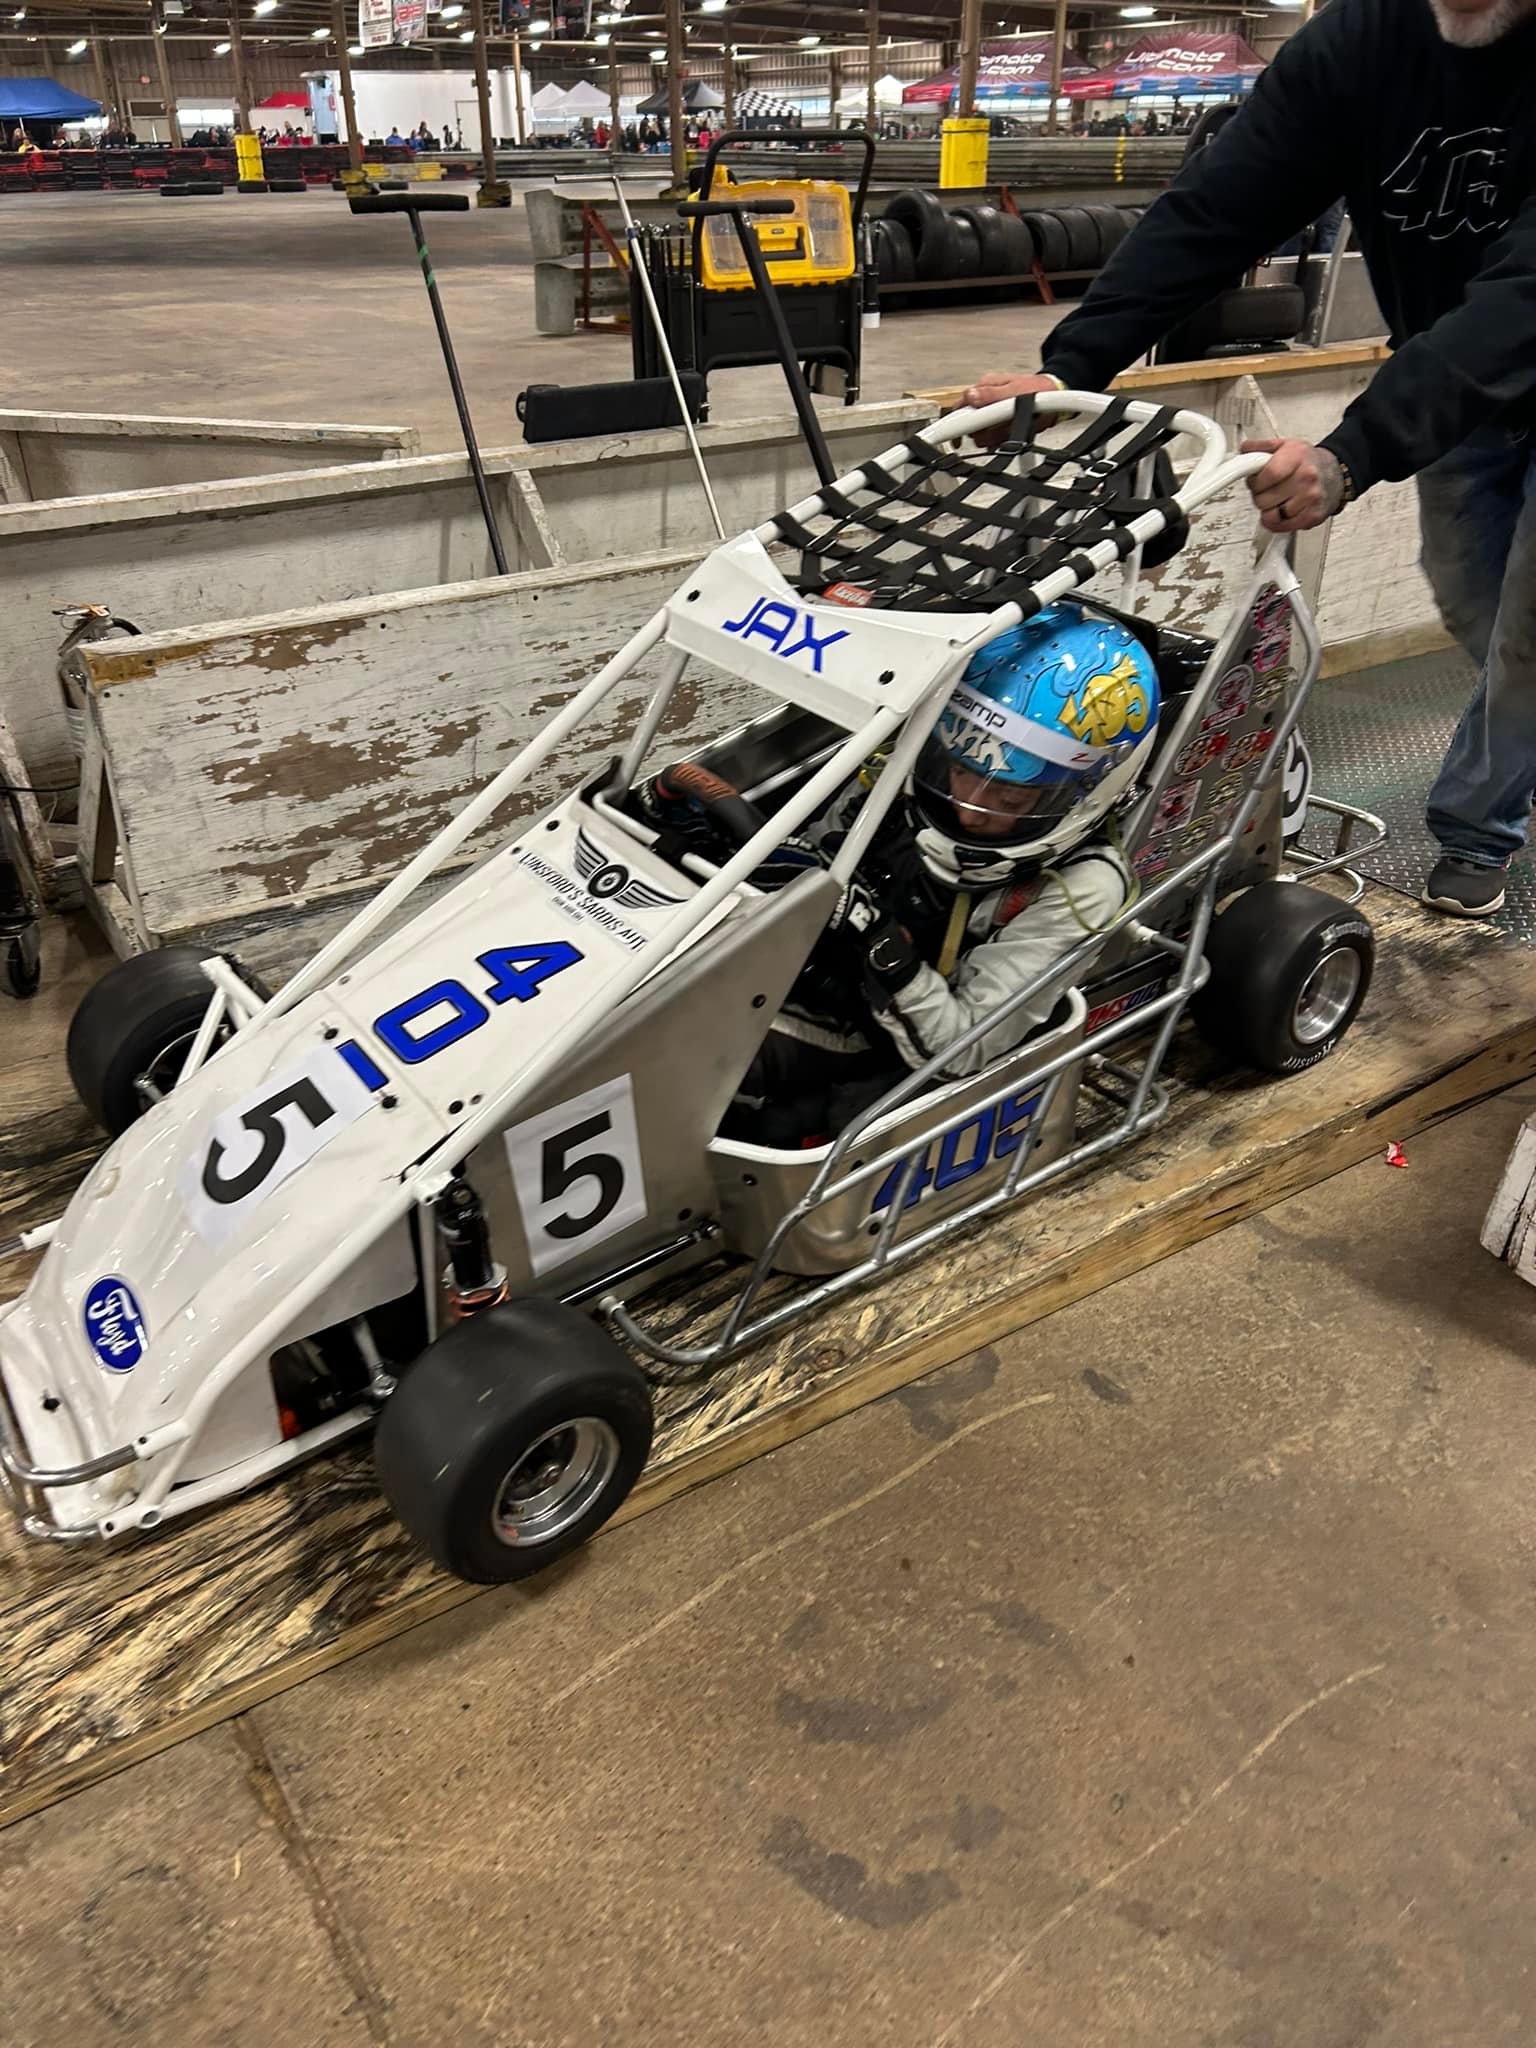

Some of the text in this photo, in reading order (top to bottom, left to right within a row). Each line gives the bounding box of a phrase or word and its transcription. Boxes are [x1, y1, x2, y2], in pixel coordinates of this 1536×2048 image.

[721, 596, 851, 674] JAX
[576, 895, 625, 932] SARDIS
[203, 1077, 337, 1206] 5
[540, 1109, 626, 1241] 5
